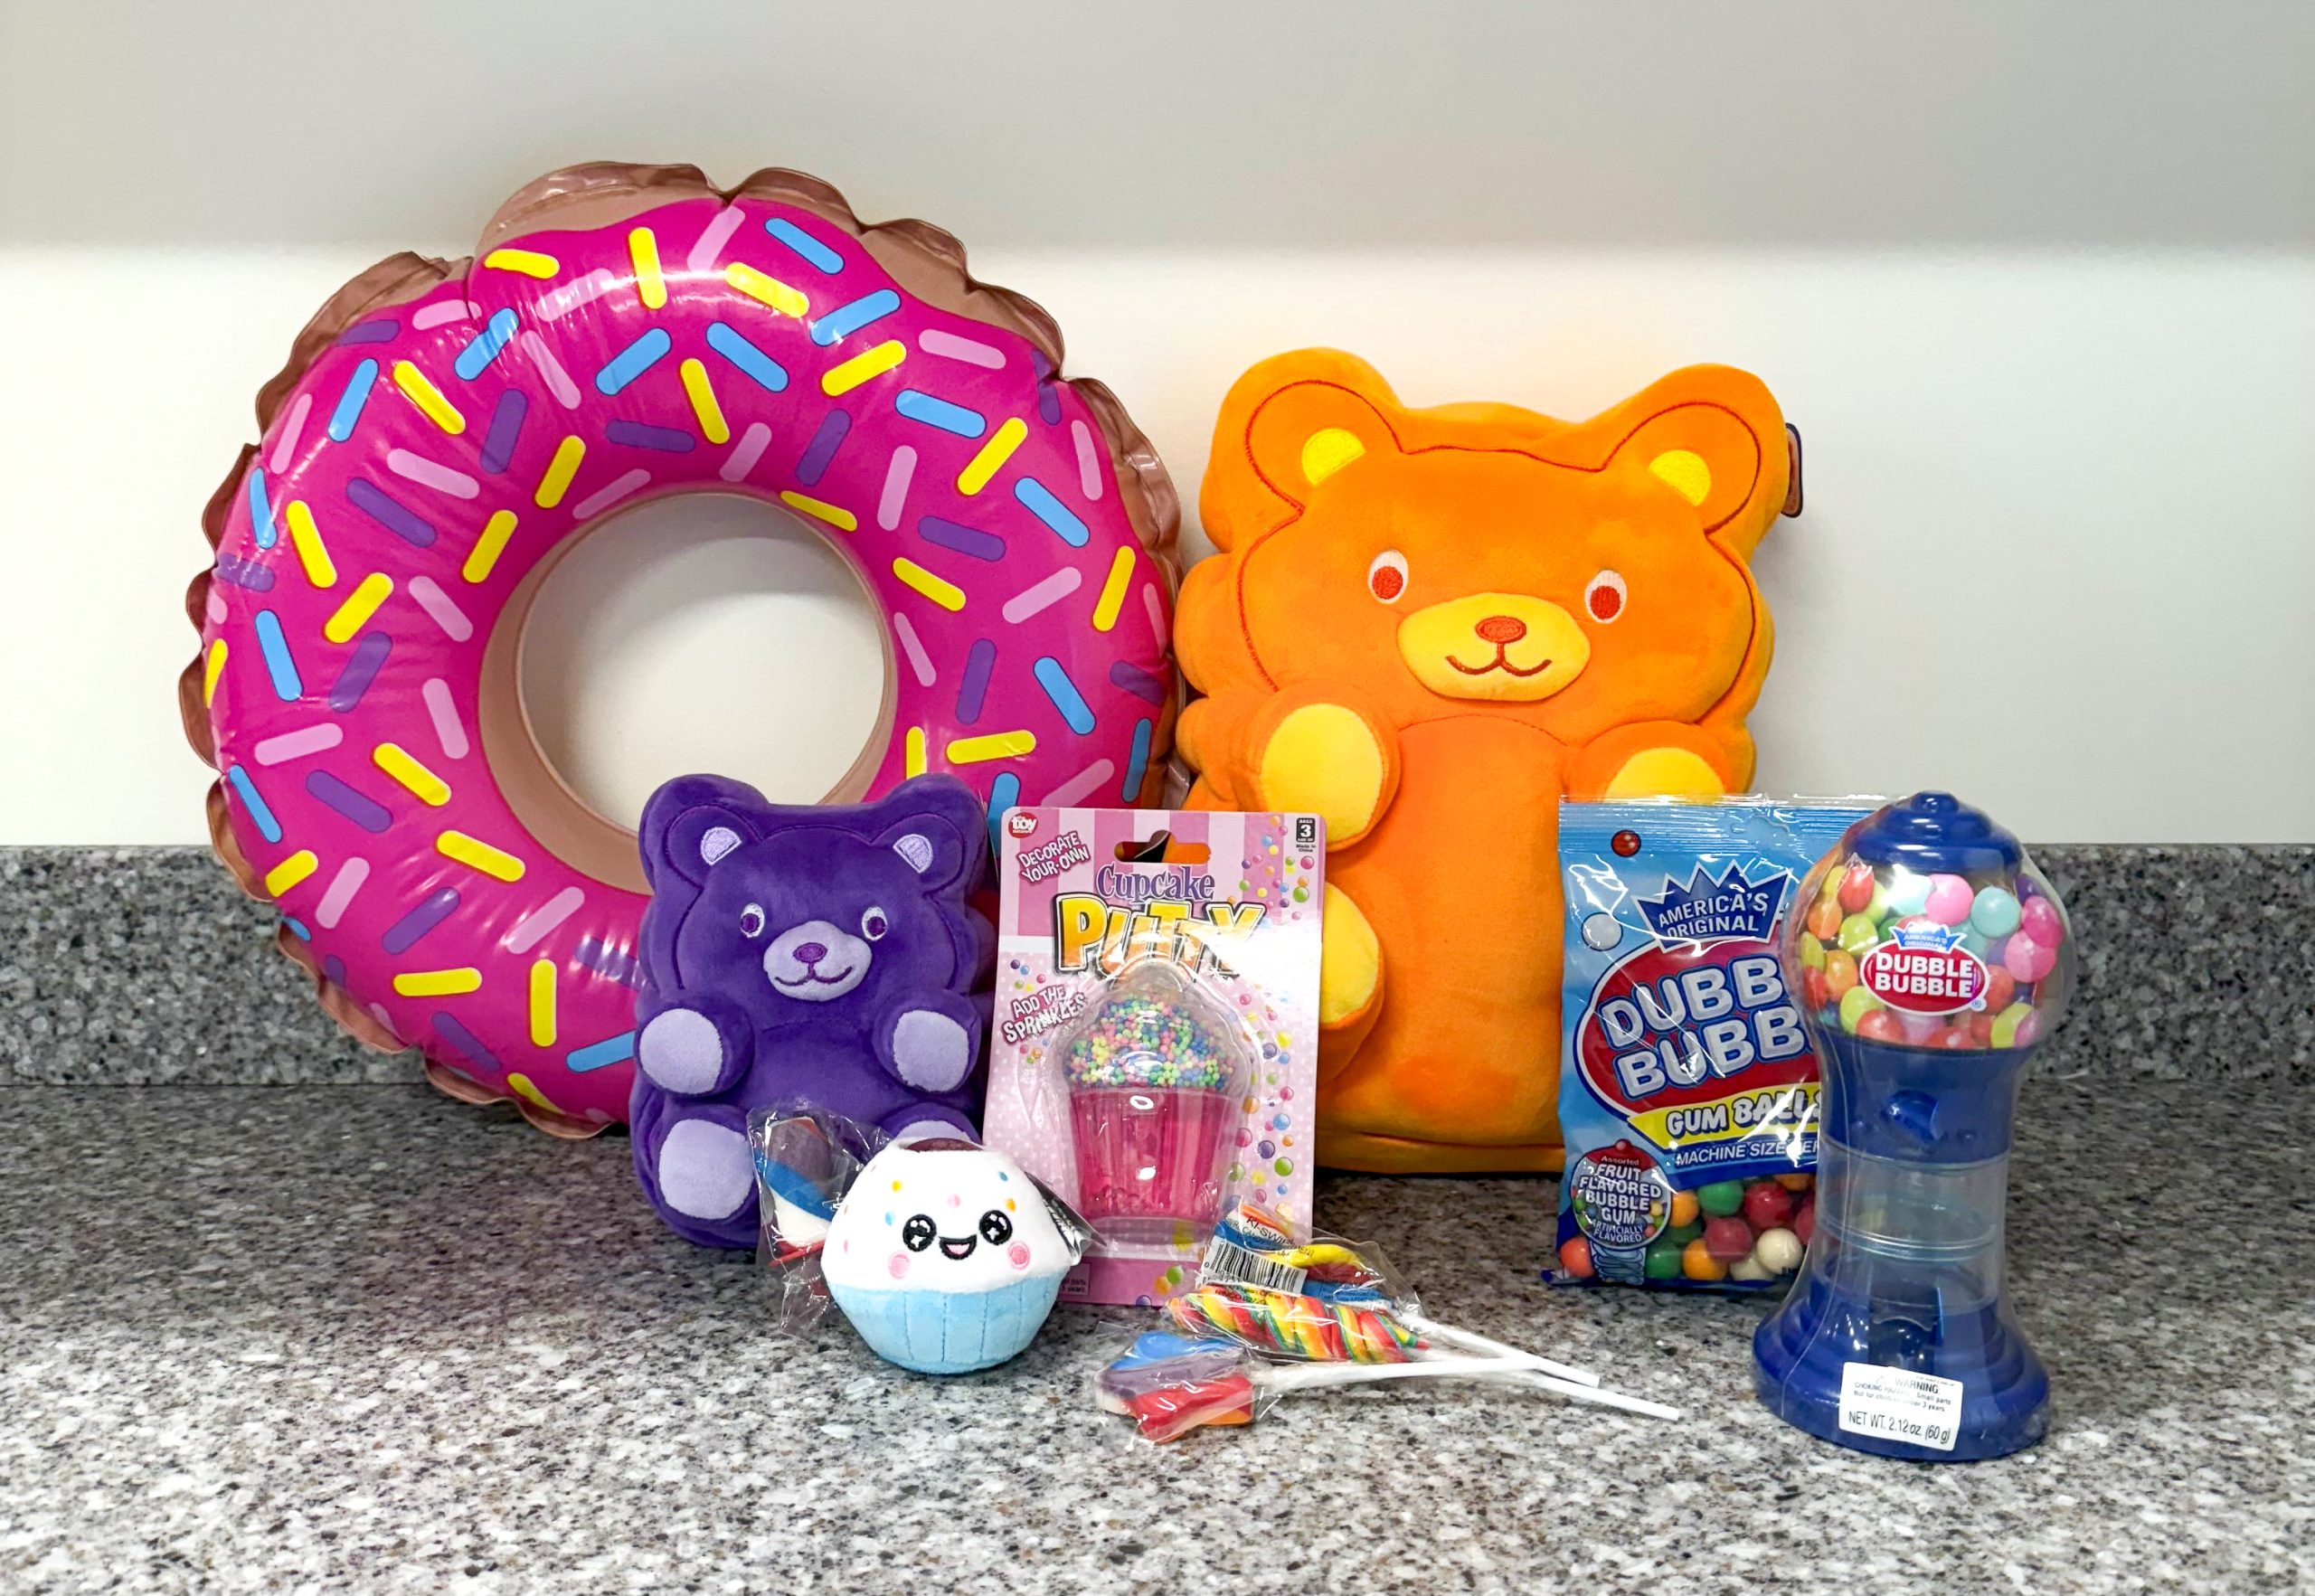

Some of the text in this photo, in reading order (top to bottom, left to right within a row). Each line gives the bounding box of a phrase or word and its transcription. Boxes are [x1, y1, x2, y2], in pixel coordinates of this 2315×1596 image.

[1299, 824, 1312, 837] 3
[1018, 832, 1080, 868] DECORATE
[1097, 864, 1215, 903] Cupcake
[1658, 892, 1770, 928] AMERICA'S
[1667, 915, 1760, 938] ORIGINAL
[1876, 952, 1974, 978] DUBBLE
[1875, 972, 1973, 998] BUBBLE
[1012, 986, 1064, 1019] ADD THE
[1601, 957, 1783, 1048] DUBB
[1003, 993, 1086, 1043] SPRINKLES
[1616, 1006, 1805, 1097] BUBB
[1667, 1105, 1727, 1136] GUM
[1601, 1156, 1639, 1166] Assorted
[1677, 1144, 1746, 1166] MACHINE
[1750, 1141, 1787, 1157] SIZE
[1596, 1163, 1642, 1181] FRUIT
[1579, 1176, 1662, 1198] FLAVORED
[1585, 1189, 1649, 1211] BUBBLE
[1601, 1207, 1637, 1224] GUM
[1593, 1229, 1642, 1243] FLAVORED
[1848, 1411, 1868, 1425] NET
